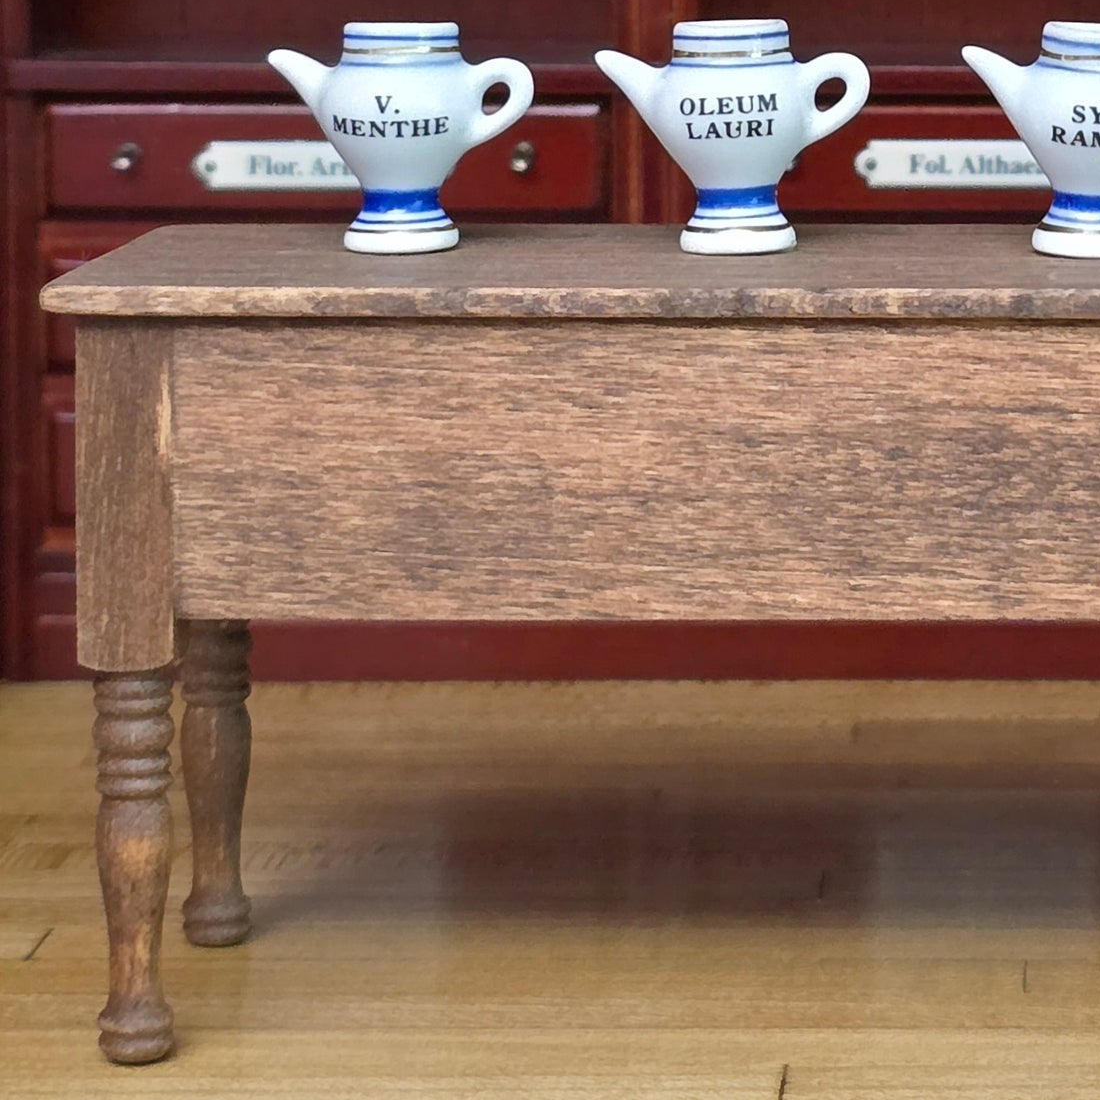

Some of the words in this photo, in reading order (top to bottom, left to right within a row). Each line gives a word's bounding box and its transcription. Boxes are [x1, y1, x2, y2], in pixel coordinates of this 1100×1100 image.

[374, 95, 401, 115] V.
[679, 93, 779, 116] OLEUM
[332, 114, 450, 139] MENTHE
[685, 118, 775, 140] LAURI
[249, 154, 304, 177] Flor.
[908, 153, 952, 176] Fol.
[957, 153, 1043, 176] Althae
